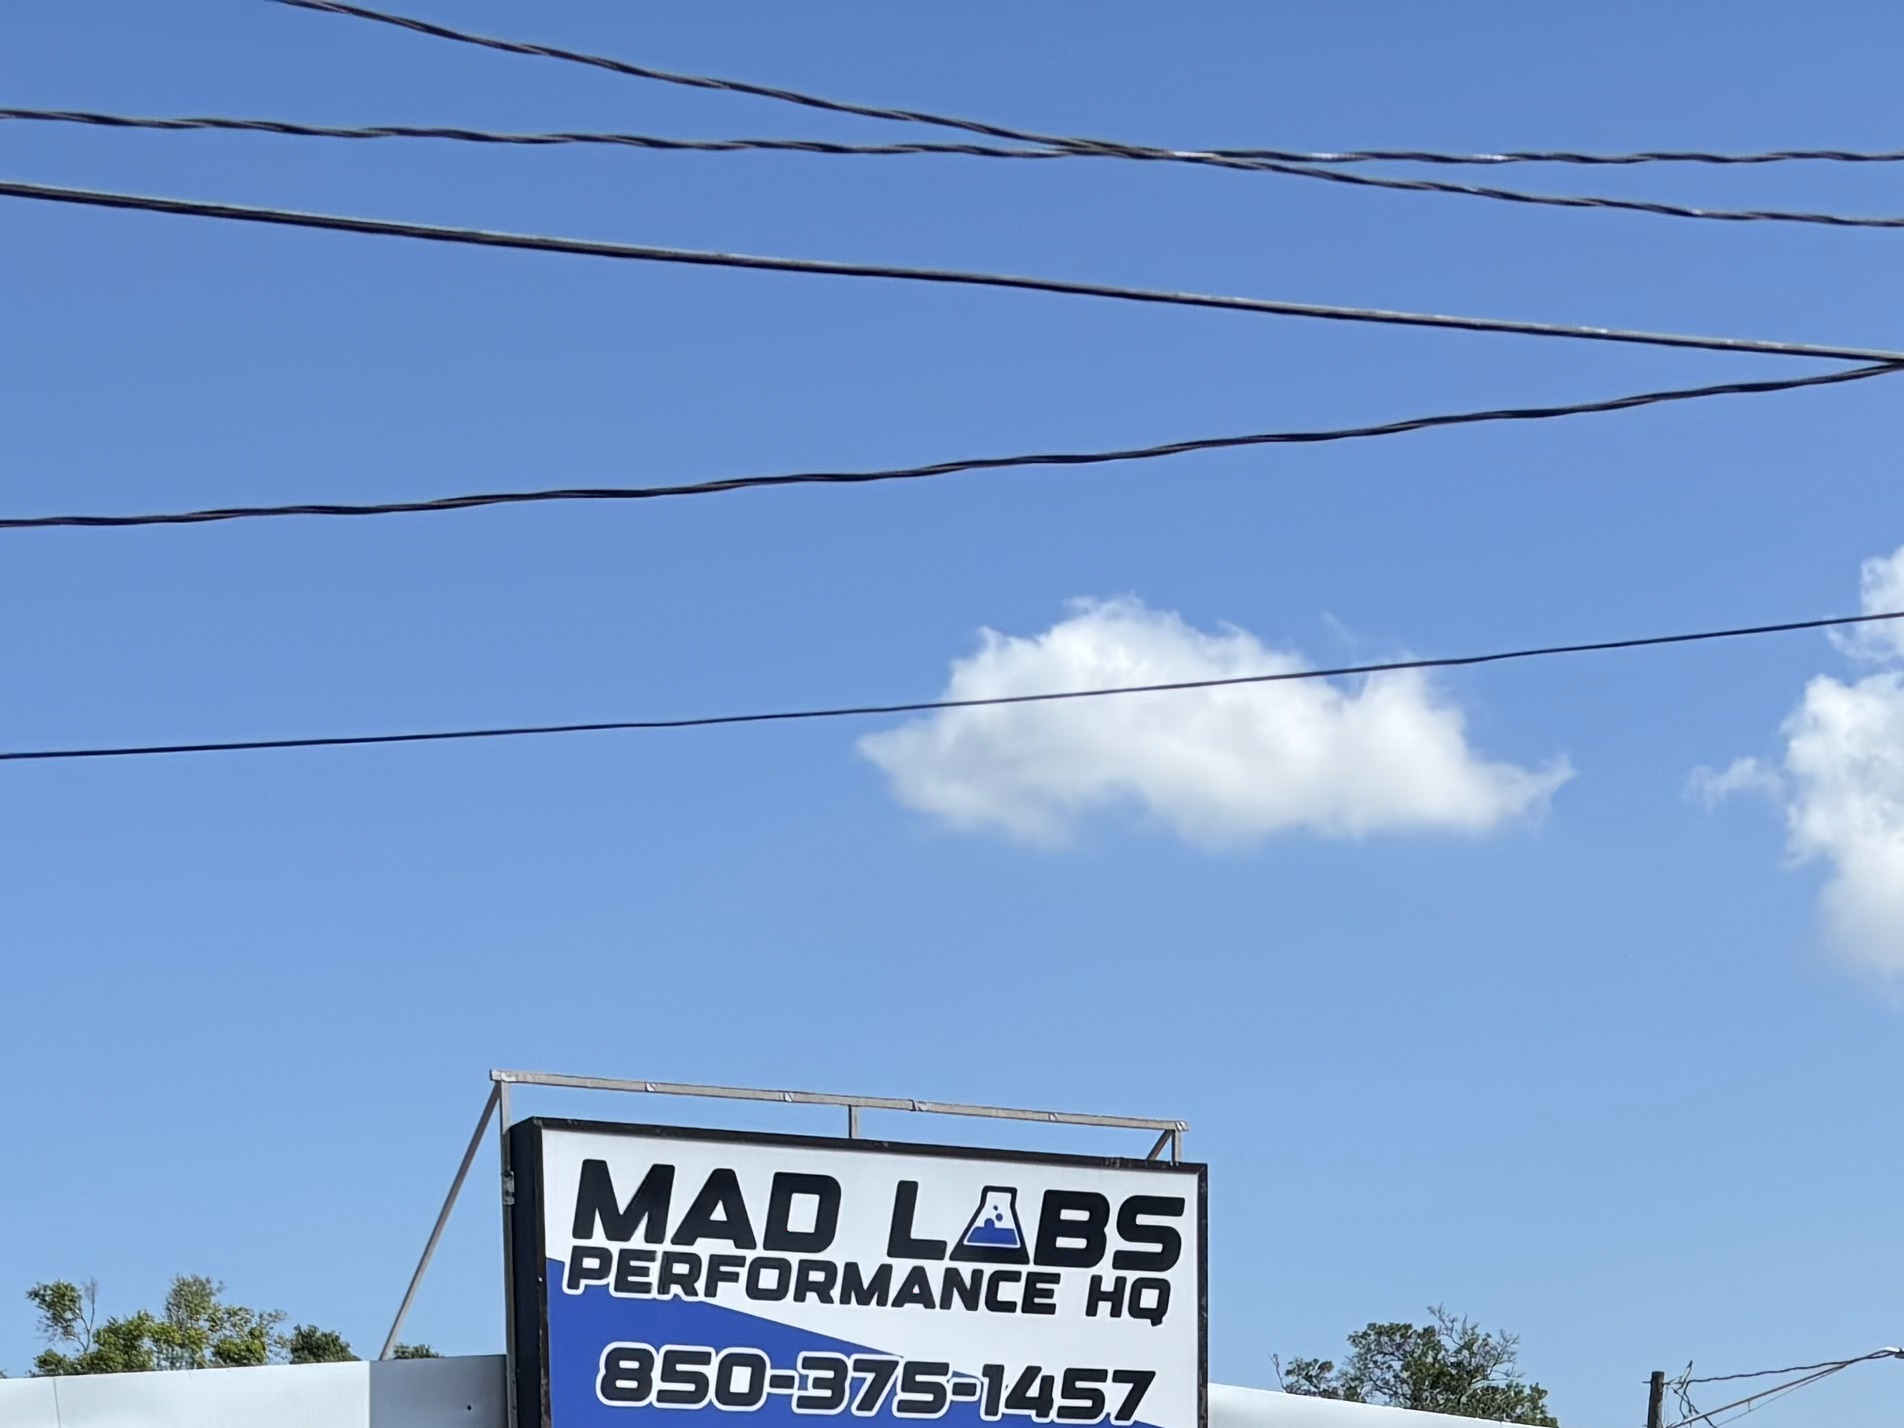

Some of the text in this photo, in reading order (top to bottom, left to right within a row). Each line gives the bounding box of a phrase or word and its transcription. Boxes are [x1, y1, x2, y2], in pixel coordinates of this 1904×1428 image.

[573, 1158, 1186, 1272] MAD LABS
[565, 1244, 1172, 1328] PERFORMANCE HQ
[599, 1347, 1157, 1424] 850-375-1457
